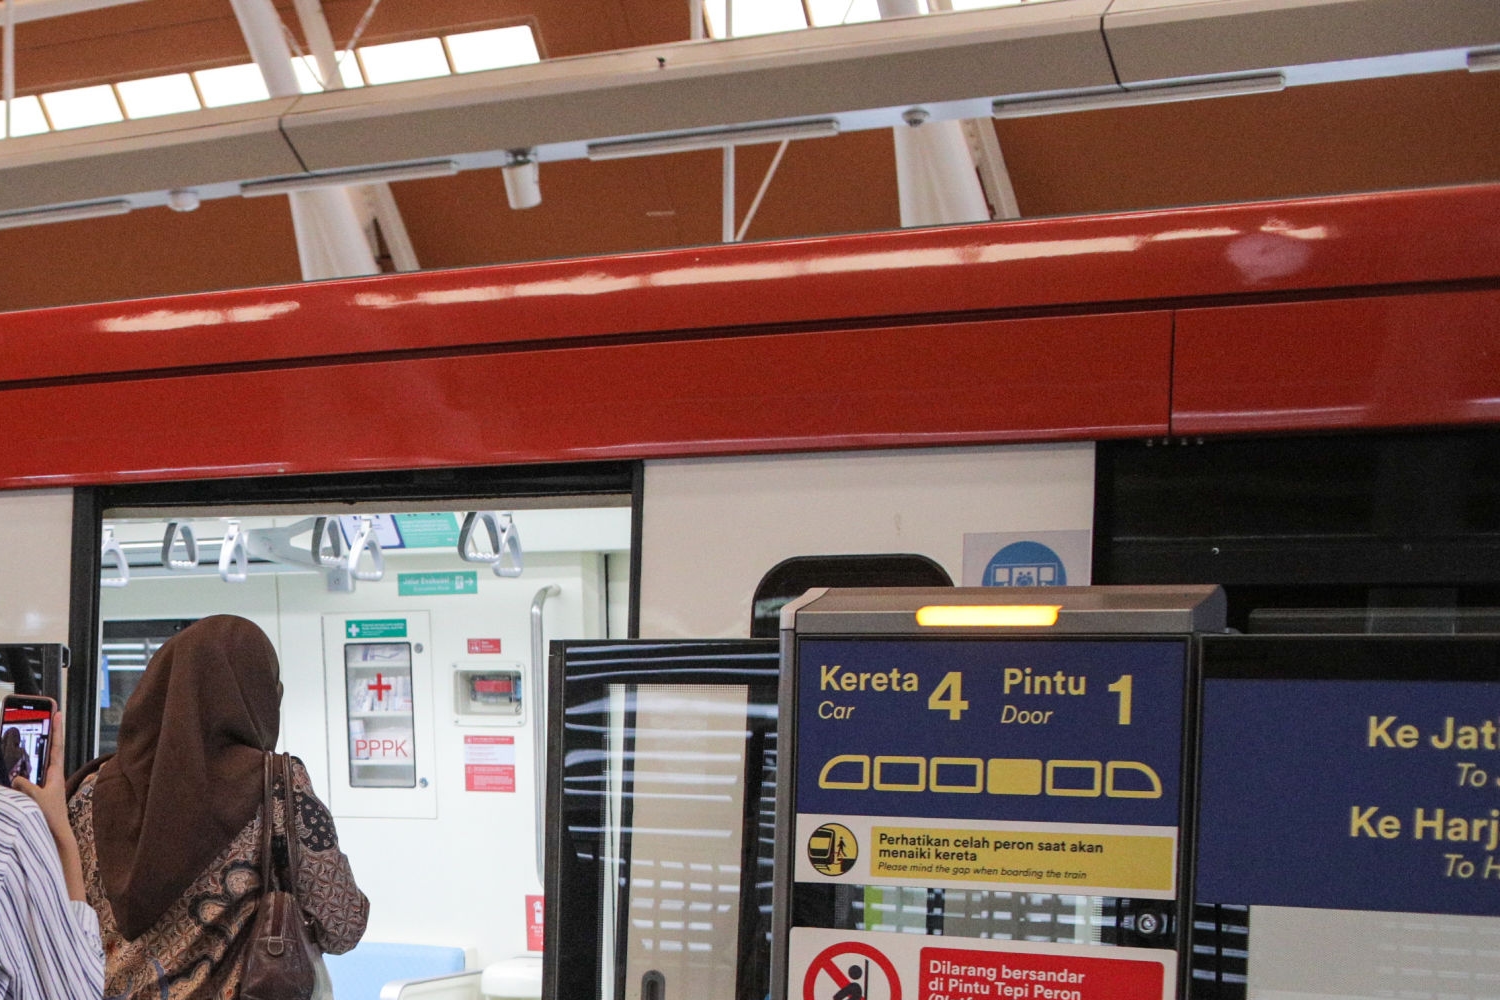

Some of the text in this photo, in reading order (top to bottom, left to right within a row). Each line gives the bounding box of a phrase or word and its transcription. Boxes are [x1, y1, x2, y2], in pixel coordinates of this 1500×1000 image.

[820, 665, 969, 720] Kereta 4
[1004, 667, 1132, 725] Pintu 1
[818, 700, 855, 719] Car
[1000, 704, 1054, 724] Door
[1368, 715, 1500, 749] Ke Jat
[355, 739, 408, 757] PPPK
[1457, 762, 1488, 787] To
[1350, 805, 1500, 850] Ke Harj
[879, 833, 1103, 853] Perhatikan celah peron saat akan
[879, 847, 977, 862] menaiki kereta
[878, 862, 1087, 880] Please mind the gap when boarding the train
[1444, 853, 1475, 878] To
[929, 960, 1085, 984] Dilarang bersandar
[928, 978, 1081, 1000] di Pintu Tepi Peron
